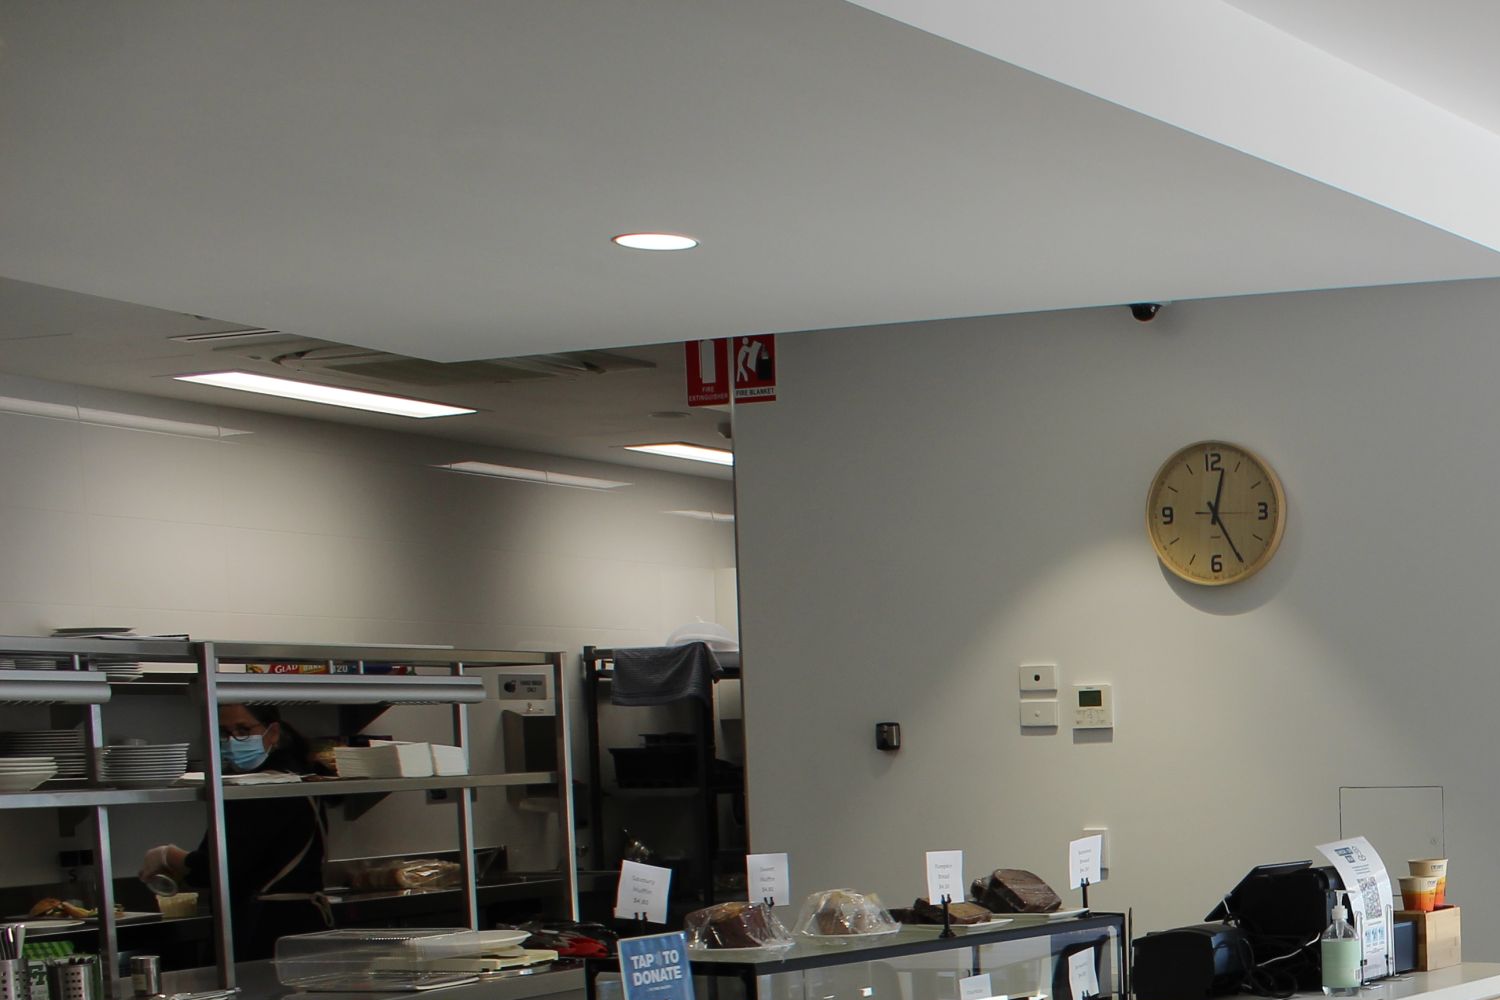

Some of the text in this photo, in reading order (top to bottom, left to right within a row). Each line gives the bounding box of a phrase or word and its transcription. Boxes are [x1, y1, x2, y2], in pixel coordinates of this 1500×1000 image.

[689, 393, 728, 401] EXTINGUISHER
[736, 387, 774, 397] FIRE BLANKET
[1204, 453, 1223, 472] 12
[1161, 506, 1174, 525] 9
[1257, 502, 1269, 520] 3
[1210, 554, 1223, 573] 6
[274, 664, 299, 674] GLAD
[630, 950, 680, 969] TAP TO
[633, 966, 682, 986] DONATE
